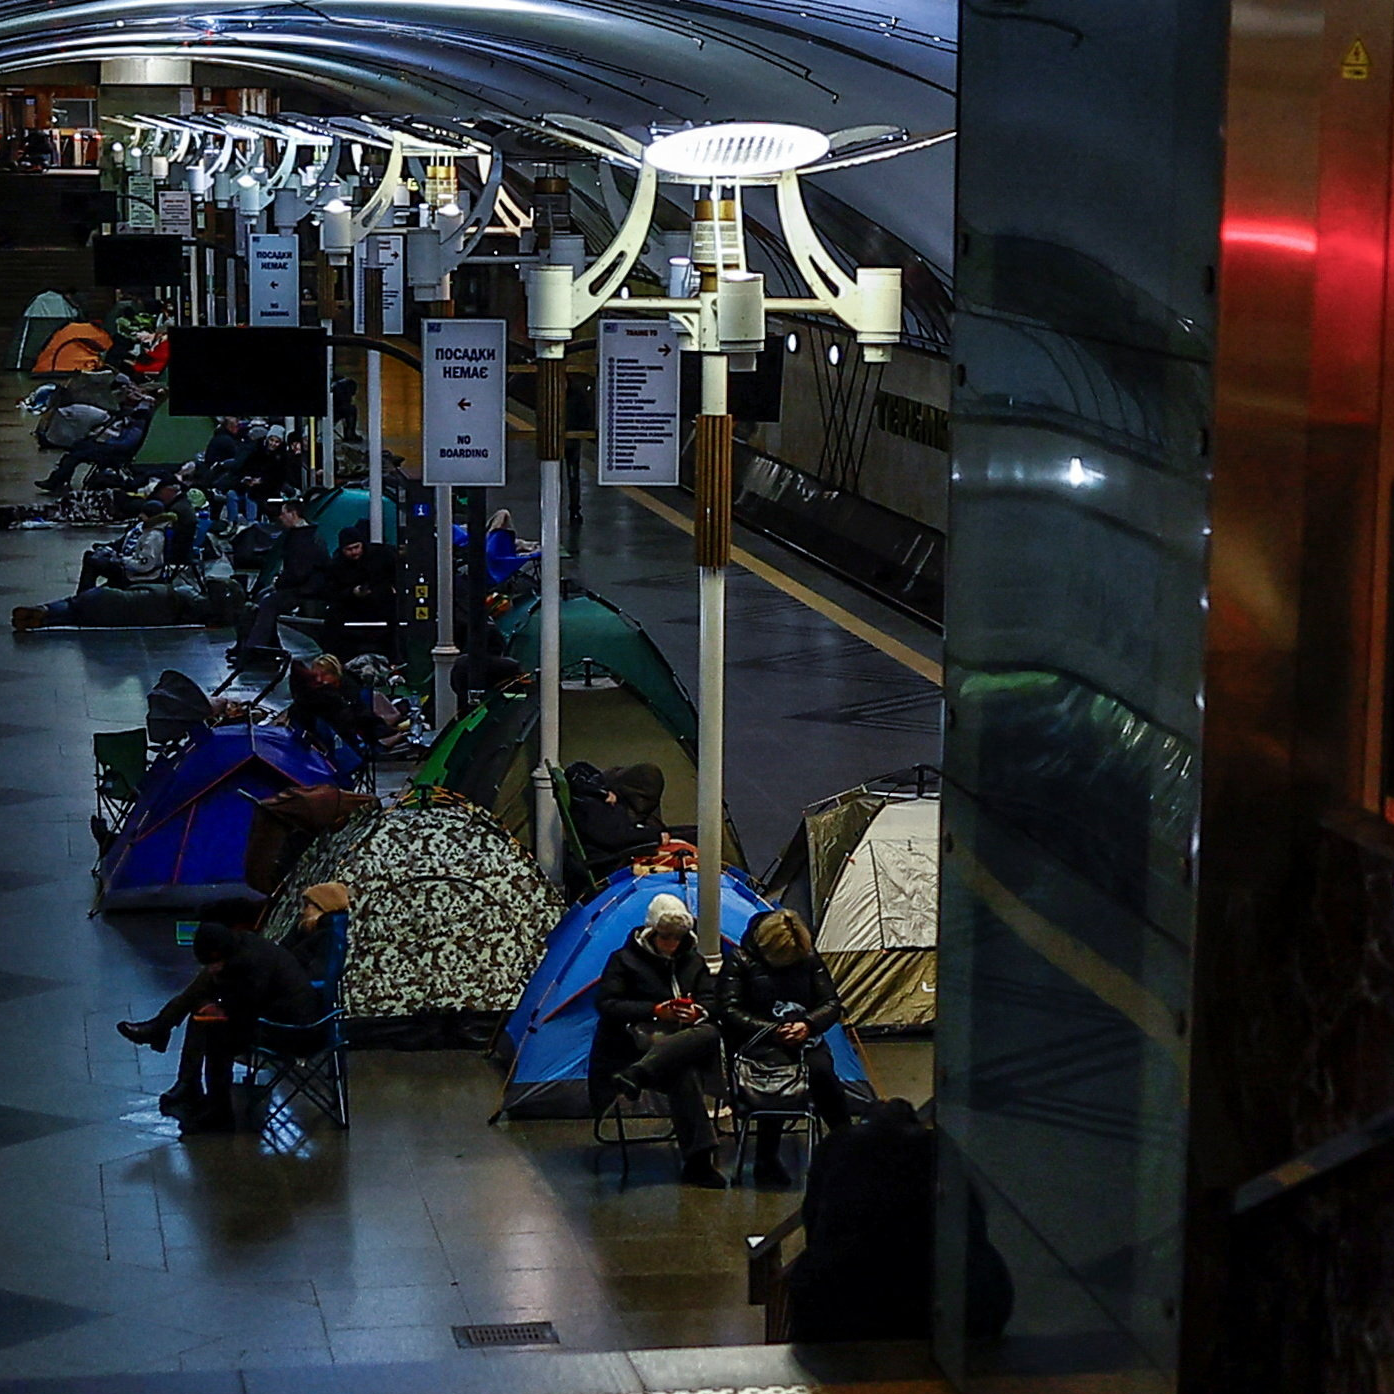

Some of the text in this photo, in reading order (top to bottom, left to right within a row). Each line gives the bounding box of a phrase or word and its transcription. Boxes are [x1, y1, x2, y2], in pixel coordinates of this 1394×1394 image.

[435, 348, 495, 362] ПОСАДКИ
[443, 366, 488, 379] НЕМАЄ
[457, 435, 471, 445] NO
[439, 448, 489, 458] BOARDING
